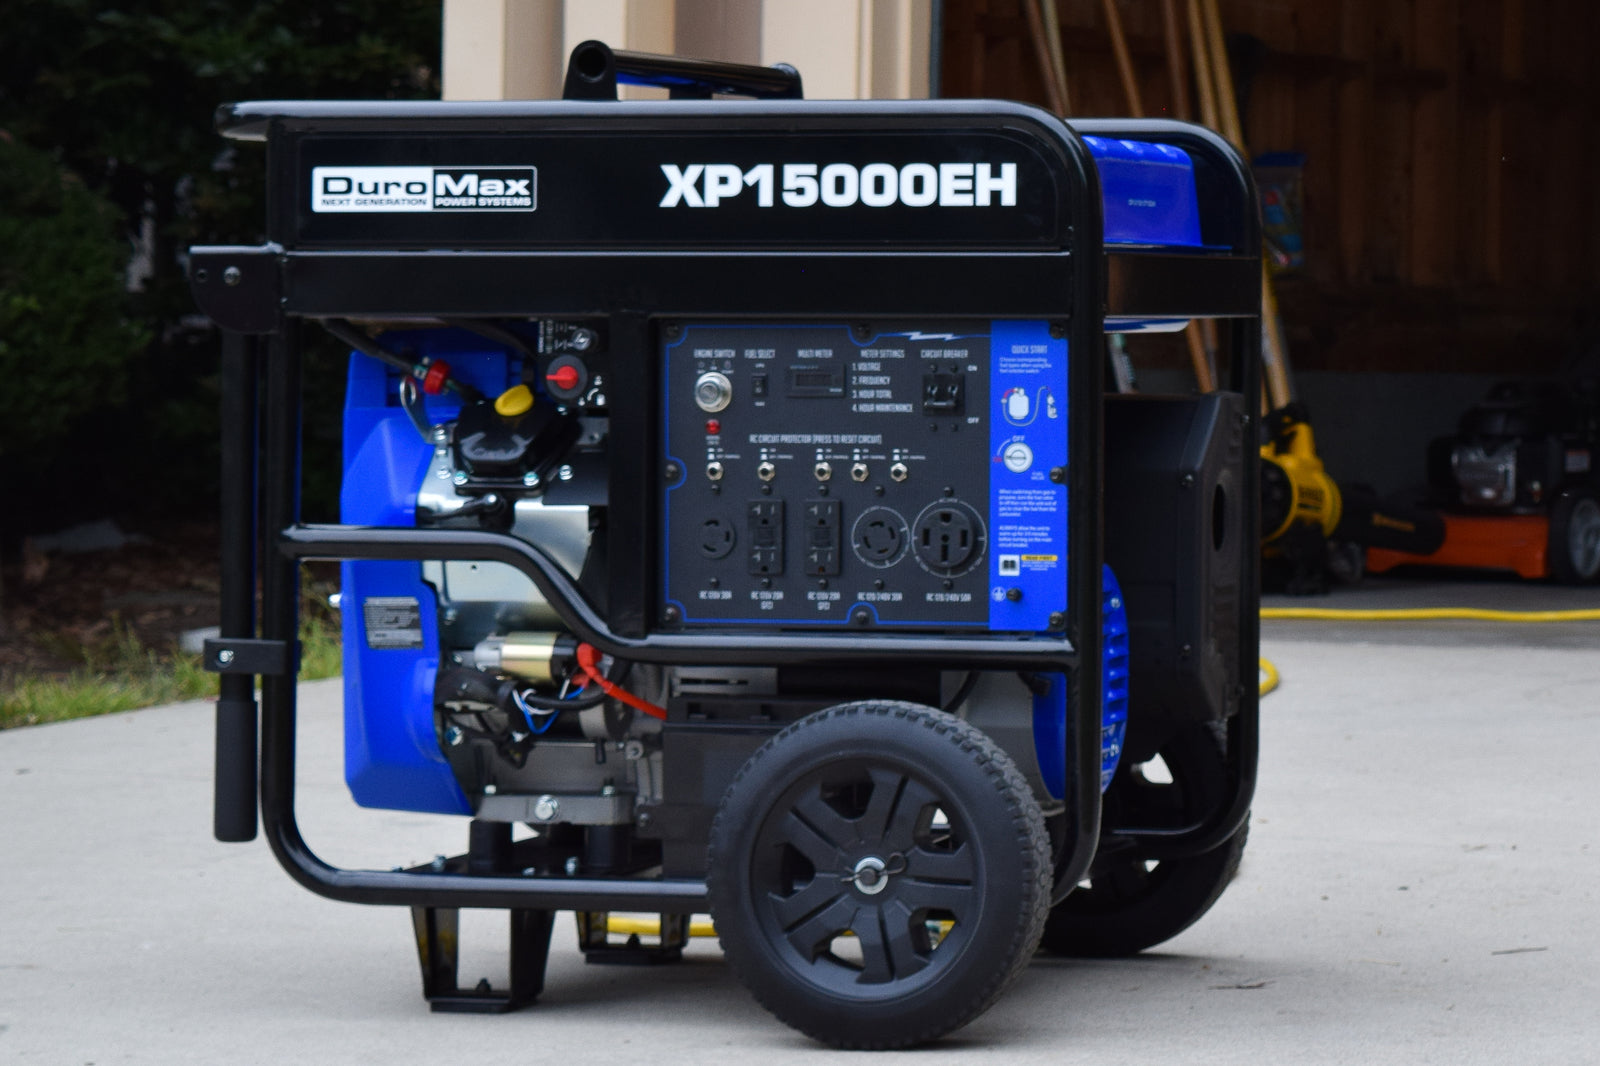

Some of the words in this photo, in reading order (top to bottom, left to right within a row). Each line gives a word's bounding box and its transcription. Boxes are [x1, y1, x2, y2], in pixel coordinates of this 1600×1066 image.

[659, 163, 1017, 208] XP15000EH
[321, 199, 351, 207] NEXT
[355, 199, 427, 207] GENERATION
[435, 197, 477, 207] POWER
[478, 197, 532, 207] SYSTEMS
